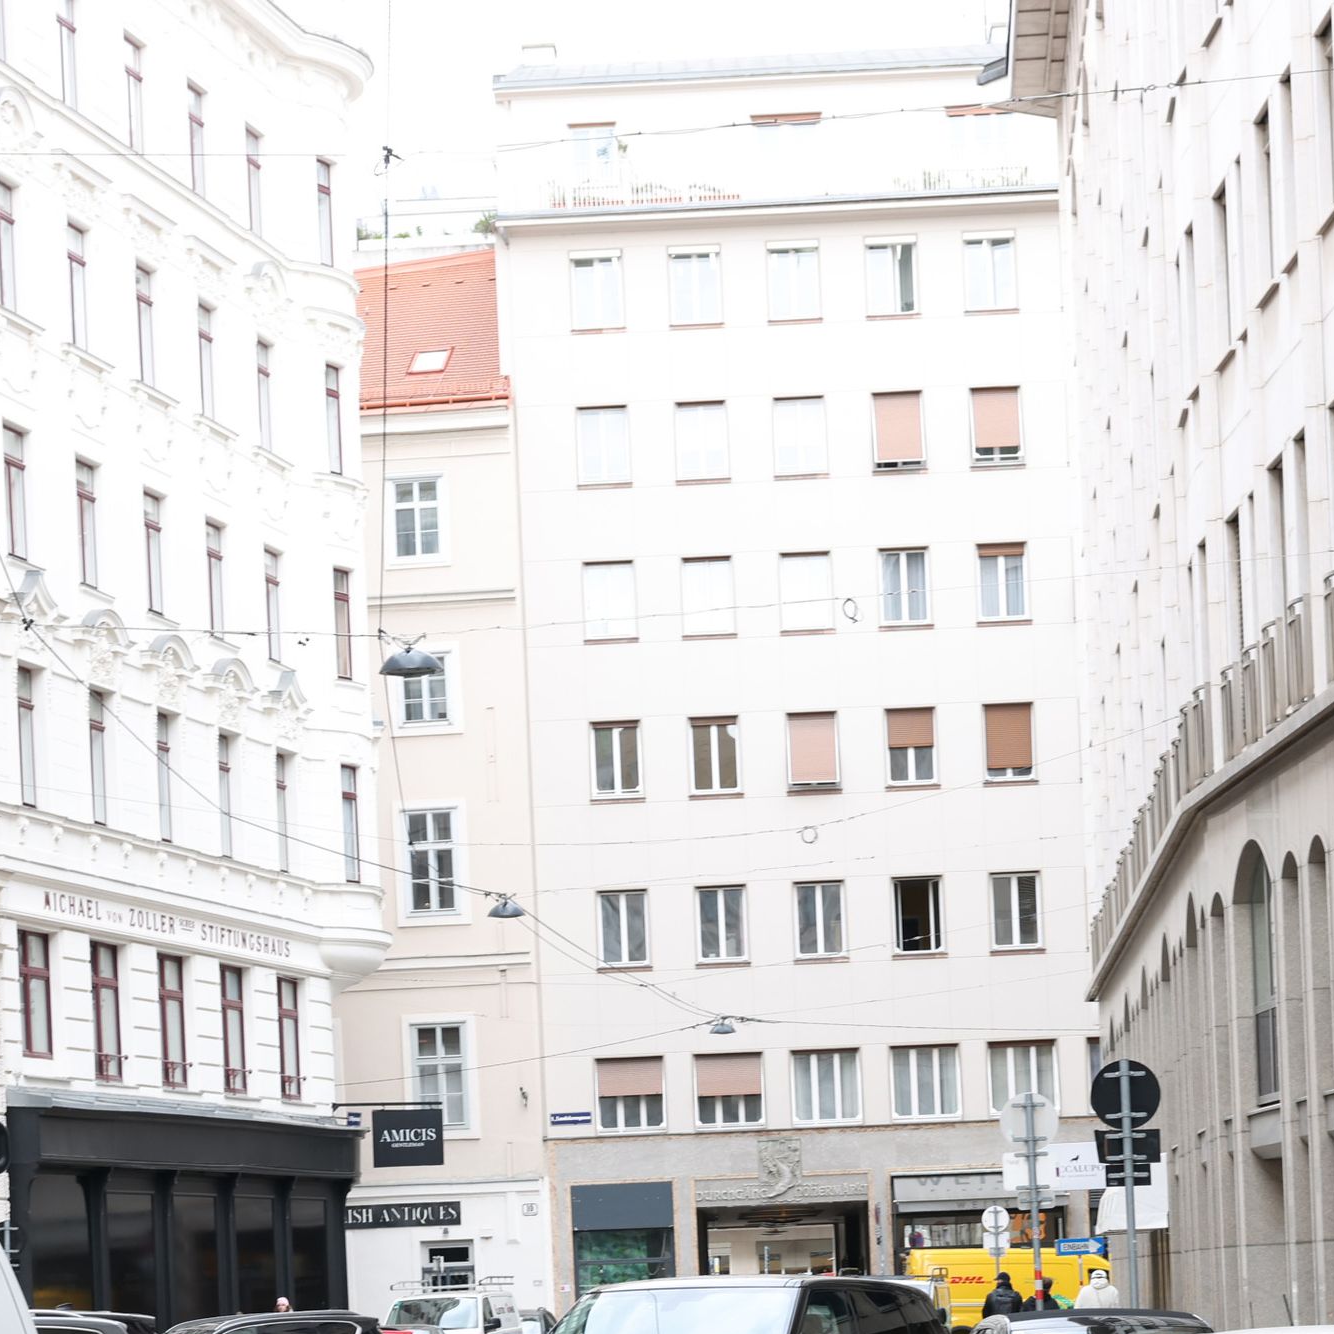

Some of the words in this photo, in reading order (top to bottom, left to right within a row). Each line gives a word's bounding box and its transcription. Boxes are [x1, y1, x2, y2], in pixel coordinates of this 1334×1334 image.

[43, 890, 103, 921] MICHAEL
[129, 908, 176, 935] ZOLLER
[200, 923, 292, 958] STIFTUNGSHAUS
[378, 1127, 437, 1143] AMICIS
[345, 1207, 373, 1225] ISH
[379, 1205, 458, 1224] ANTIQUES
[1062, 1243, 1090, 1251] EINBAHN
[950, 1276, 986, 1284] DHL
